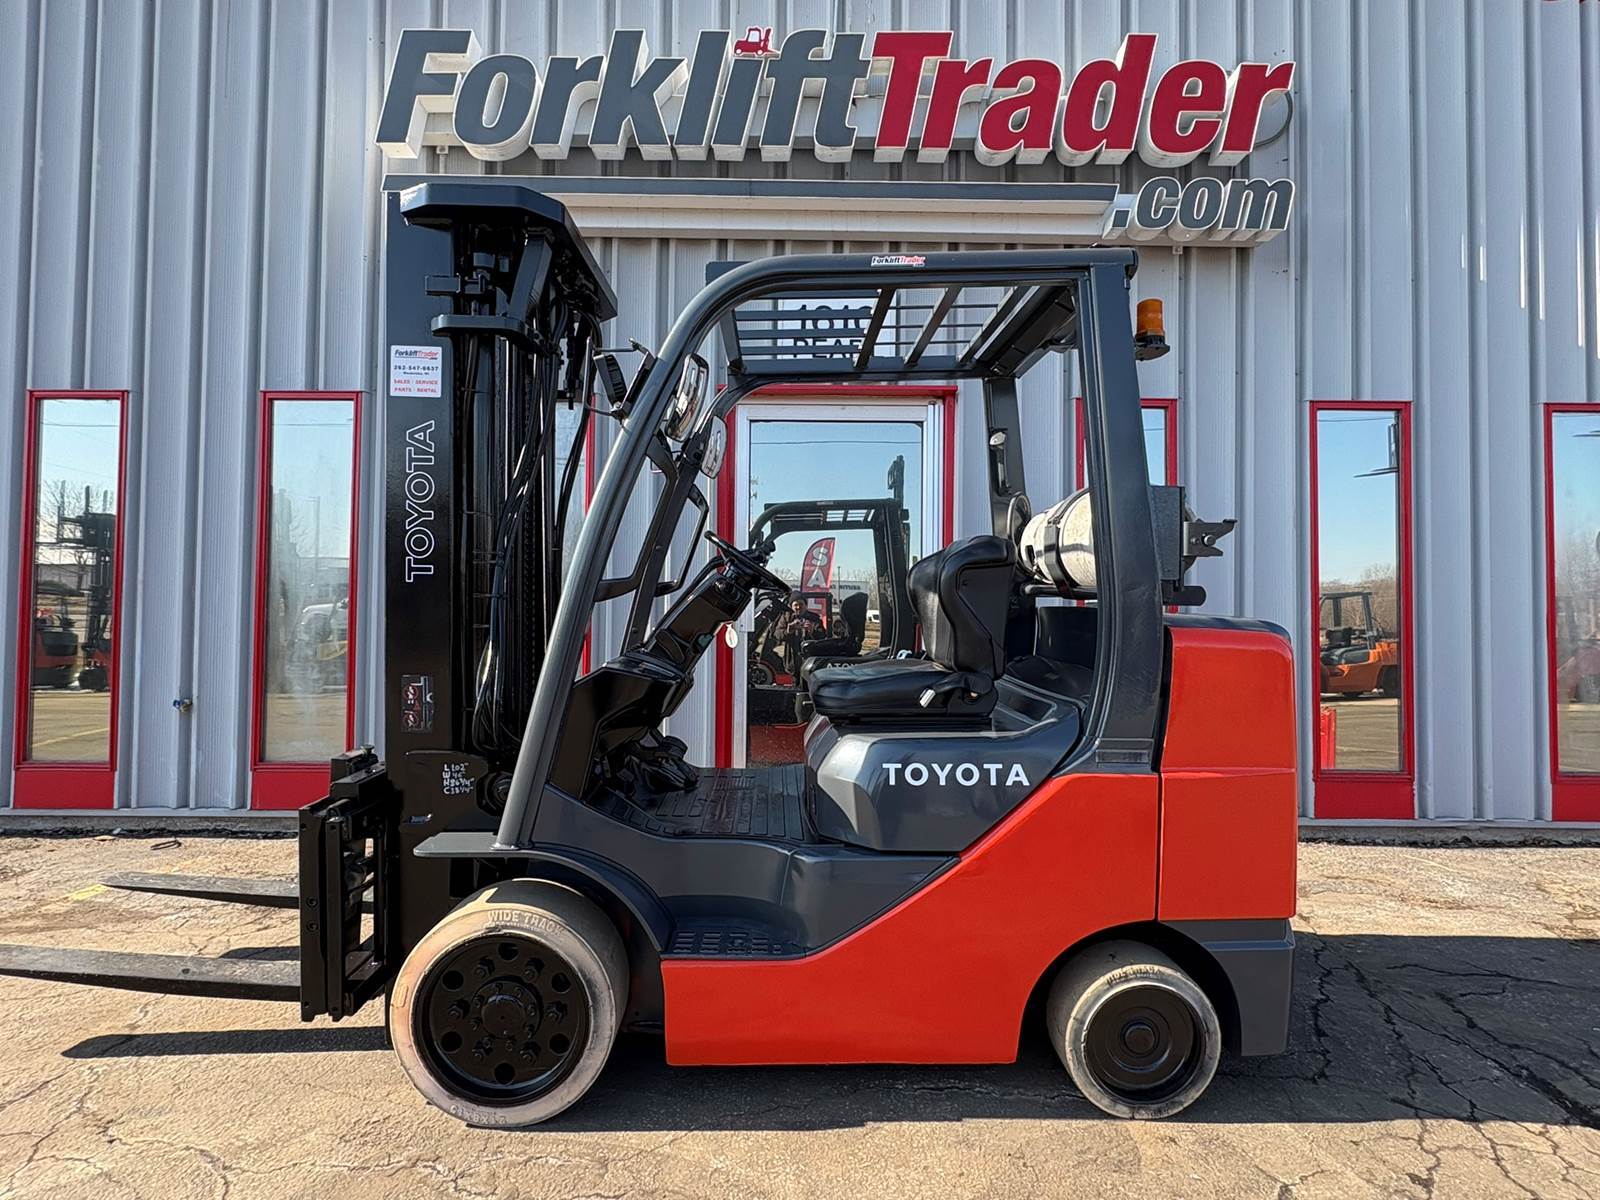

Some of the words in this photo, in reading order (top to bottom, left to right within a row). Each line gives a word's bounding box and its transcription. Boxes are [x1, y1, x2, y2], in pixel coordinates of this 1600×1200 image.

[375, 28, 1295, 154] ForkliftTrader
[1112, 176, 1295, 230] .com
[405, 419, 435, 583] TOYOTA
[882, 762, 1030, 787] TOYOTA
[487, 910, 520, 923] WIDE
[523, 913, 566, 936] TRACK
